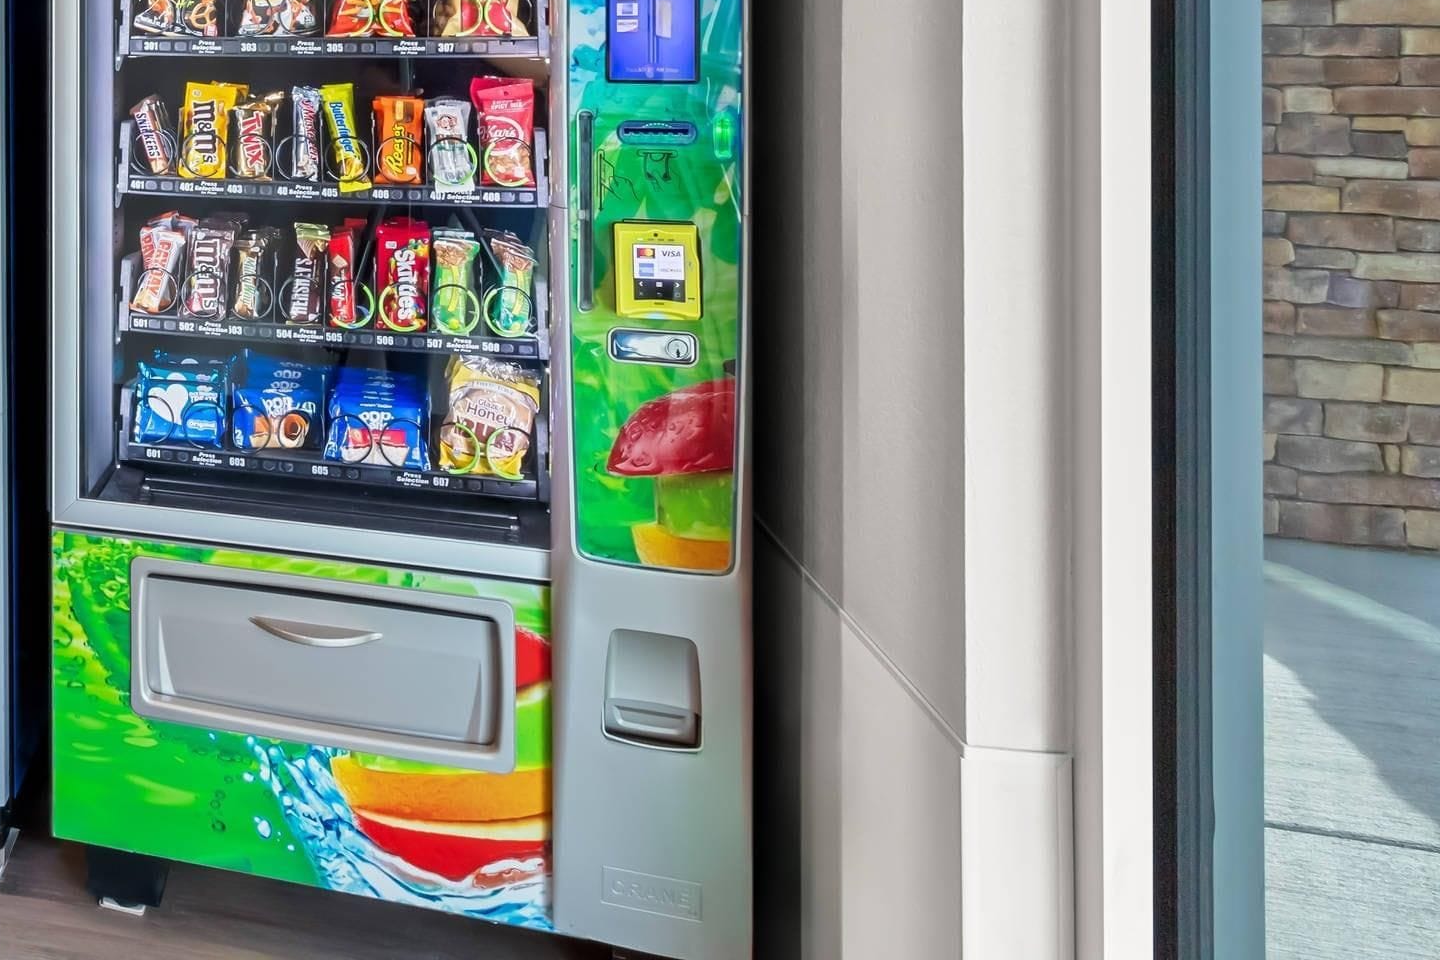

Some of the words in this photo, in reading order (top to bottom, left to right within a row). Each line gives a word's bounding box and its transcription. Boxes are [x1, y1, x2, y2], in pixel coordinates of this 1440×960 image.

[144, 42, 158, 50] 301
[240, 43, 256, 52] 303
[326, 43, 343, 52] 305
[438, 43, 455, 52] 307
[130, 180, 144, 189] 401
[180, 183, 194, 192] 402
[227, 185, 242, 194] 403
[277, 186, 288, 195] 40
[321, 188, 338, 198] 405
[372, 190, 389, 199] 406
[133, 319, 148, 328] 501
[179, 322, 194, 331] 502
[276, 329, 292, 338] 504
[326, 332, 342, 342] 505
[377, 335, 394, 345] 506
[427, 338, 442, 348] 507
[146, 449, 160, 458] 601
[229, 457, 245, 467] 603
[312, 465, 328, 475] 605
[433, 477, 449, 487] 607
[610, 879, 690, 909] CRANE
